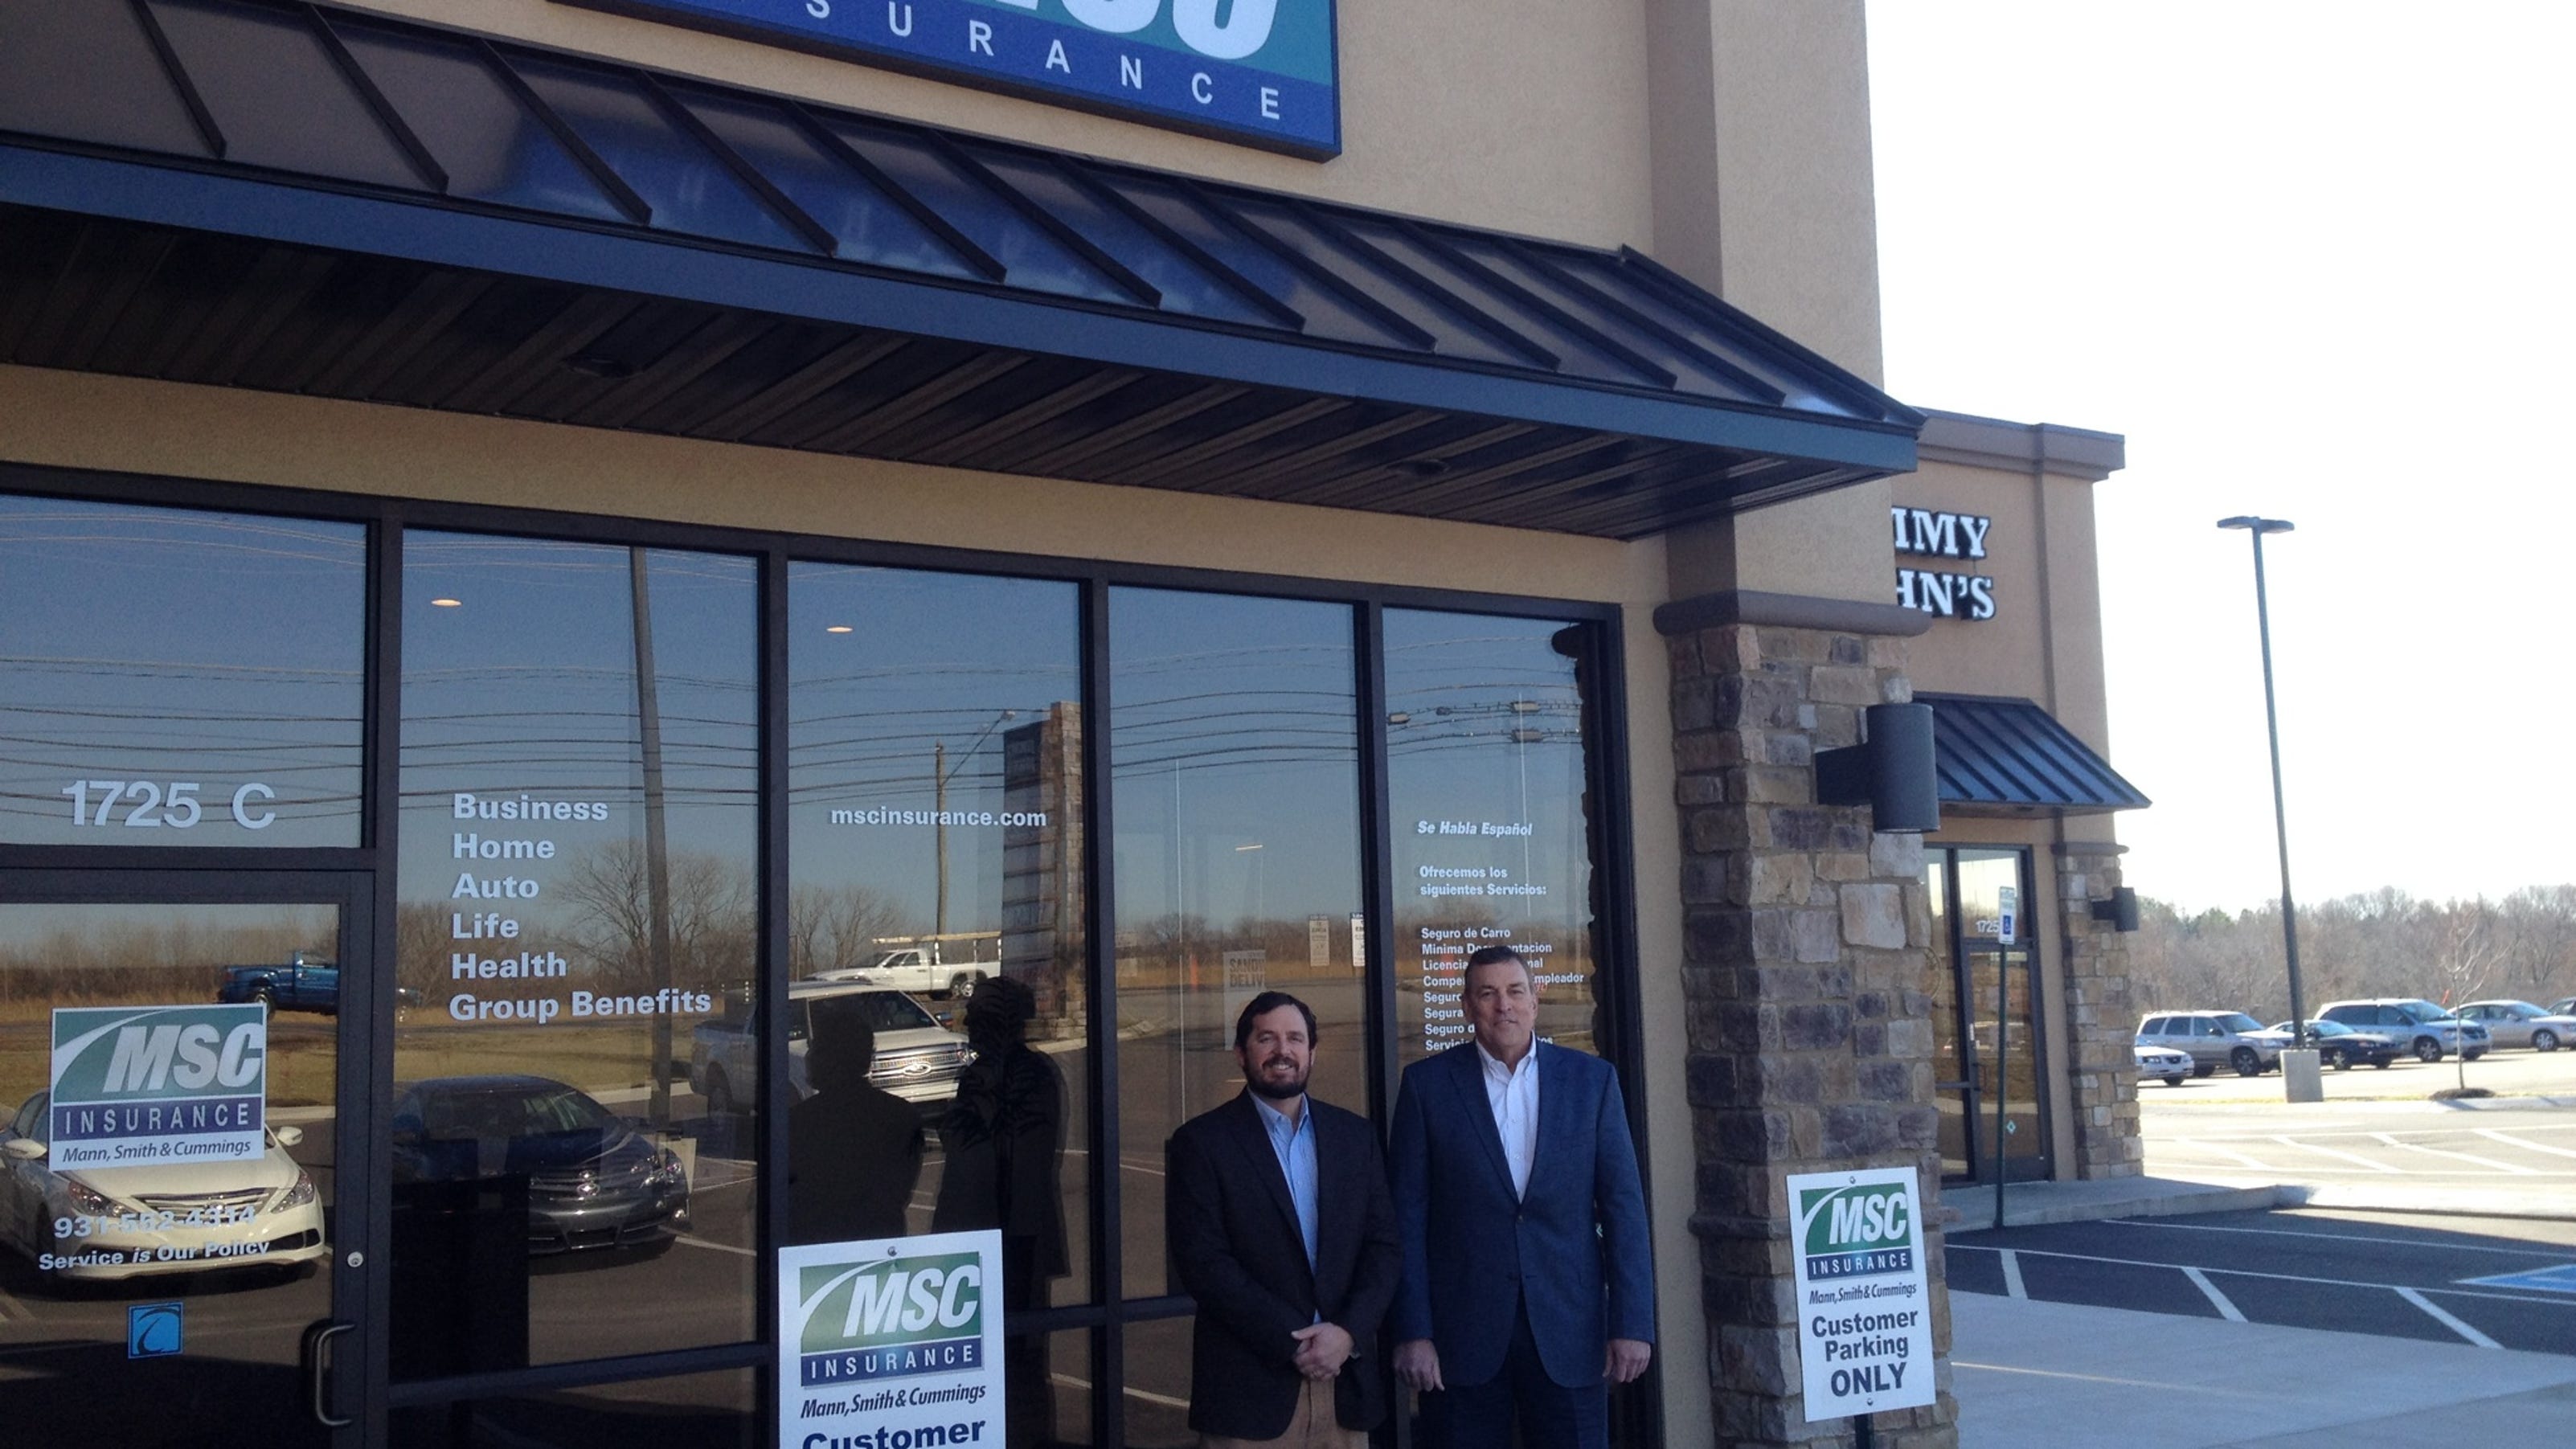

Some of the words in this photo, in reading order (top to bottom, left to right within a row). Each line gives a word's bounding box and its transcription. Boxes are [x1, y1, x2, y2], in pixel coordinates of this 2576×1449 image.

[806, 0, 1280, 120] SURANCE
[61, 780, 202, 829] 1725
[231, 783, 276, 829] C
[454, 793, 608, 821] Business
[831, 806, 1046, 827] mscinsurance.com
[1418, 821, 1435, 834] Se
[1440, 821, 1477, 835] Habla
[1481, 822, 1533, 837] Español
[453, 833, 555, 859] Home
[1419, 866, 1486, 878] Ofrecemos
[1489, 866, 1508, 878] los
[453, 873, 539, 898] Auto
[1420, 883, 1484, 898] siguientes
[1487, 883, 1547, 896] Servicios:
[452, 913, 519, 939] Life
[1421, 927, 1461, 940] Seguro
[1464, 928, 1478, 939] de
[1480, 927, 1511, 939] Carro
[1422, 943, 1464, 955] Minima
[452, 952, 567, 979] Health
[1423, 959, 1468, 971] Licencia
[1534, 972, 1584, 984] mpleador
[449, 993, 559, 1024] Group
[571, 989, 711, 1017] Benefits
[1424, 1023, 1464, 1037] Seguro
[102, 1022, 263, 1094] MSC
[65, 1103, 249, 1134] INSURANCE
[63, 1146, 110, 1163] Mann,
[114, 1141, 157, 1160] Smith
[160, 1143, 171, 1156] &
[174, 1140, 251, 1158] Cummings
[1829, 1192, 1907, 1245] MSC
[39, 1251, 124, 1270] Service
[132, 1247, 151, 1263] is
[157, 1246, 196, 1262] Our
[205, 1241, 270, 1258] Policy
[1812, 1253, 1908, 1275] INSURANCE
[843, 1265, 981, 1337] MSC
[1809, 1291, 1837, 1305] Mann,
[1838, 1287, 1863, 1302] Smith
[1864, 1287, 1870, 1299] &
[1872, 1283, 1917, 1299] Cummings
[1812, 1311, 1919, 1337] Customer
[1825, 1335, 1909, 1362] Parking
[811, 1345, 973, 1379] INSURANCE
[1831, 1362, 1907, 1397] ONLY
[801, 1399, 849, 1418] Mann,
[850, 1390, 893, 1413] Smith
[896, 1390, 907, 1406] &
[909, 1384, 986, 1405] Cummings
[802, 1420, 986, 1449] Customer
